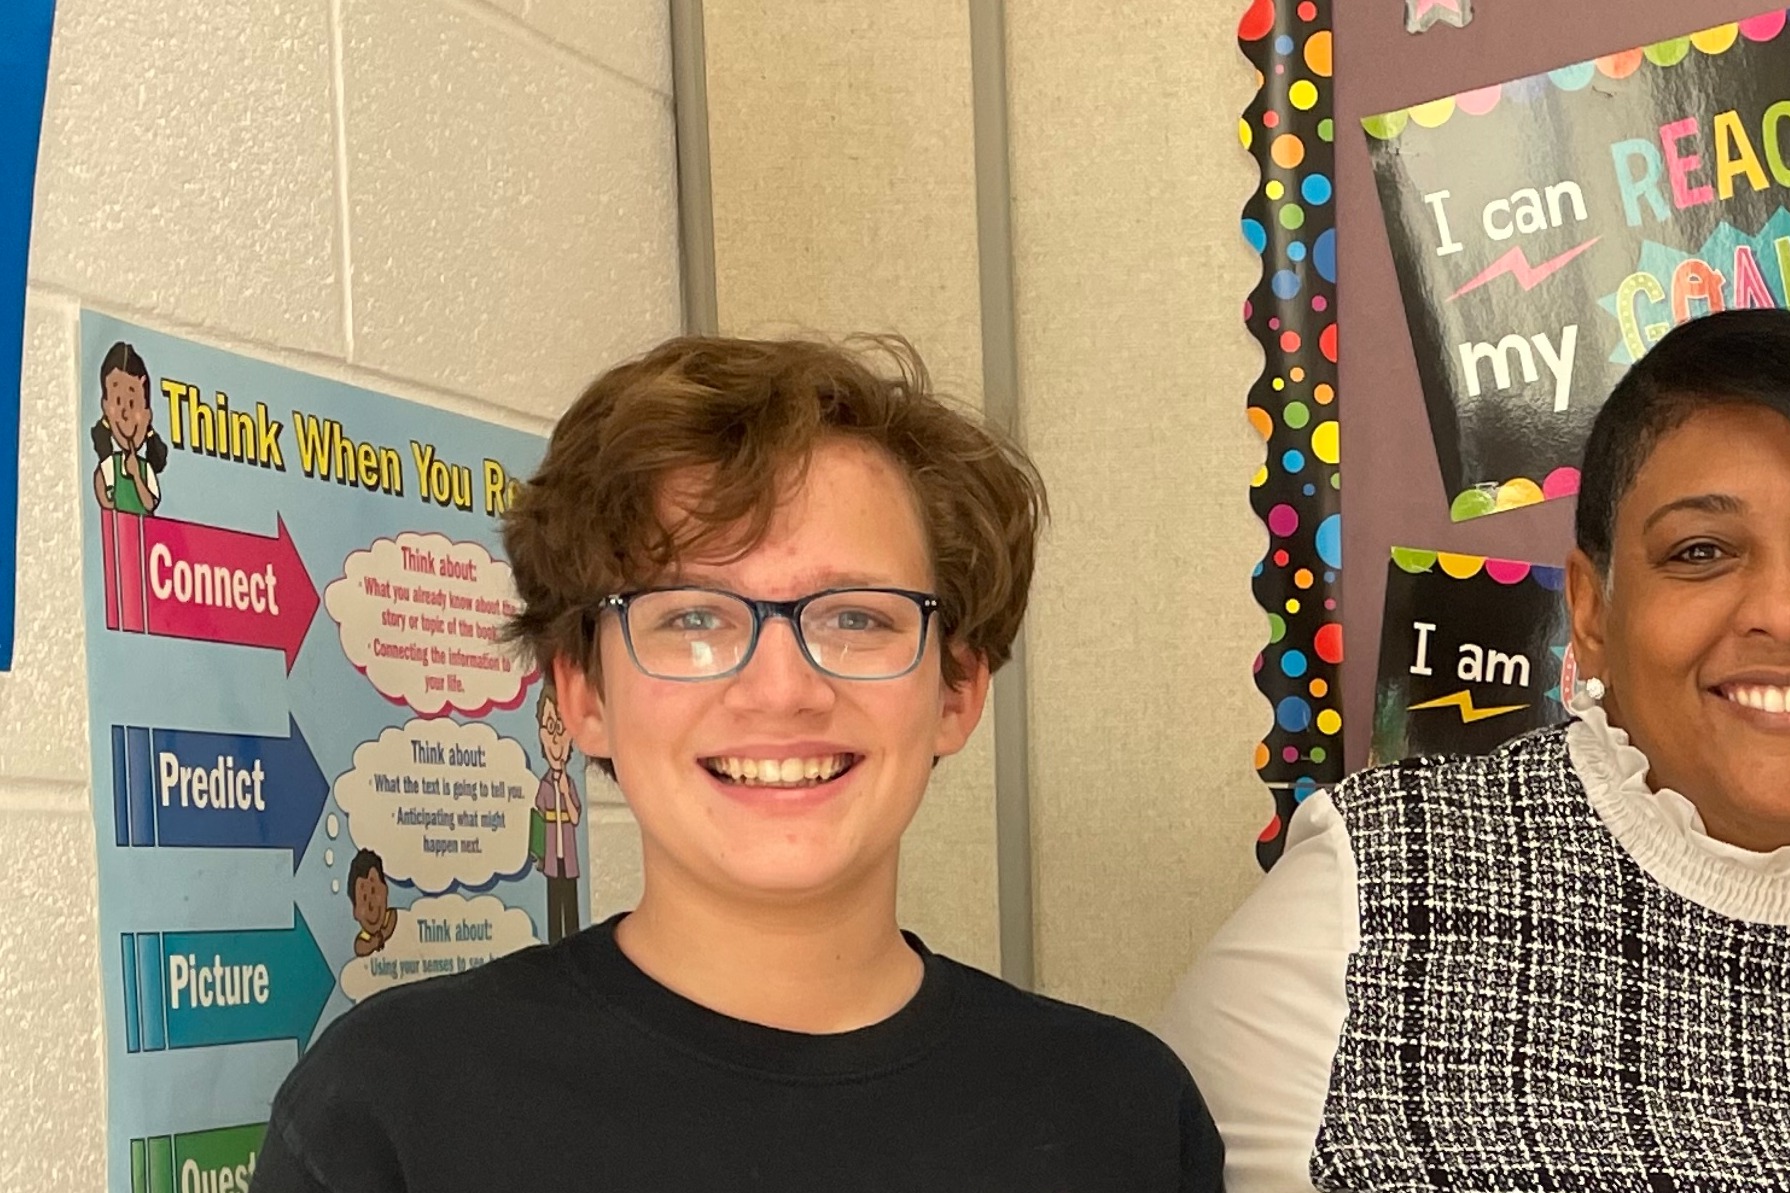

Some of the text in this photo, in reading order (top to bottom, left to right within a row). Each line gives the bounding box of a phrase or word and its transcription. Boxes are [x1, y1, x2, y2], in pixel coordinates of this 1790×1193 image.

[1424, 189, 1463, 256] I
[1481, 178, 1589, 241] can
[1458, 324, 1578, 413] my
[161, 378, 285, 472] Think
[292, 410, 403, 497] When
[410, 440, 473, 513] You
[149, 542, 279, 616] Connect
[401, 546, 477, 582] Think about:
[364, 576, 390, 599] What
[393, 585, 410, 605] you
[413, 586, 447, 612] already
[450, 592, 473, 610] know
[475, 595, 500, 613] about
[382, 608, 406, 632] story
[409, 615, 418, 630] or
[421, 614, 445, 637] topic
[447, 618, 457, 635] of
[459, 618, 473, 638] the
[373, 637, 511, 672] Connecting the information to
[1409, 621, 1436, 676] I
[1457, 643, 1531, 688] am
[424, 674, 465, 693] your life.
[411, 739, 486, 767] Think about:
[159, 752, 265, 811] Predict
[374, 773, 525, 802] What the text is going to tell you.
[396, 806, 505, 831] Anticipating what might
[423, 835, 482, 857] happen next.
[417, 918, 492, 943] Think about:
[169, 953, 269, 1009] Picture
[370, 957, 398, 979] Using
[400, 959, 419, 978] your
[422, 957, 453, 973] senses
[456, 955, 466, 972] to
